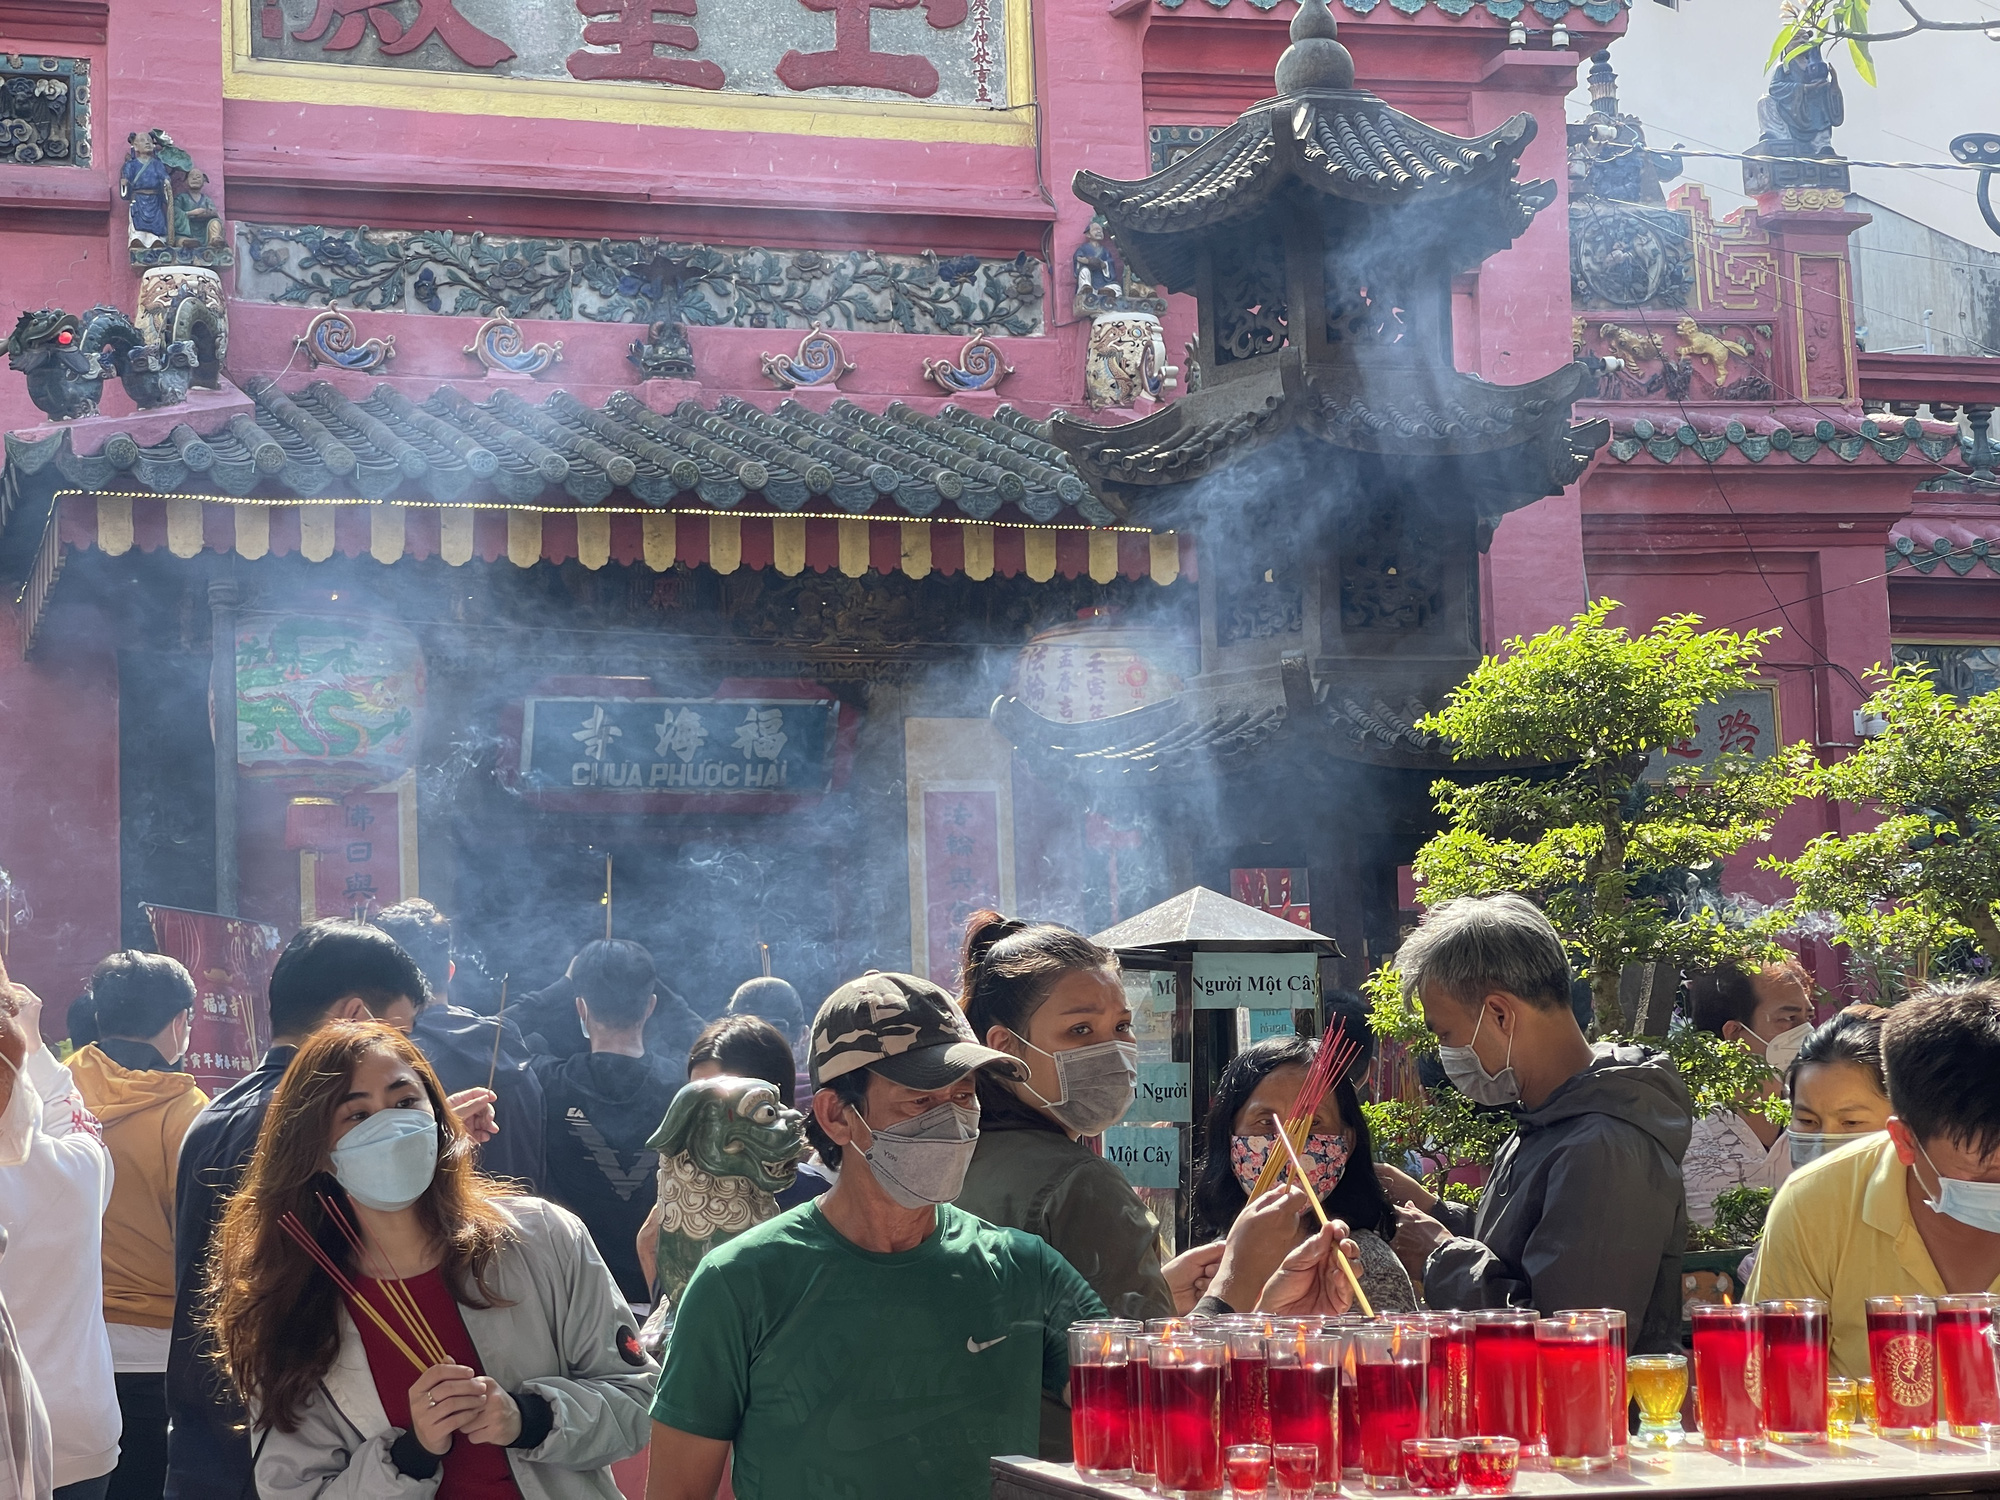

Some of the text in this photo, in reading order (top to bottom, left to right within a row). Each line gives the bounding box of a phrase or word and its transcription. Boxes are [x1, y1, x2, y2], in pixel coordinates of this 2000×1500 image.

[572, 703, 788, 763] 福海寺
[1193, 974, 1316, 996] Người Một Cây
[203, 992, 240, 1017] 福海寺
[1142, 1082, 1188, 1103] Người
[1108, 1146, 1174, 1167] Một Cây
